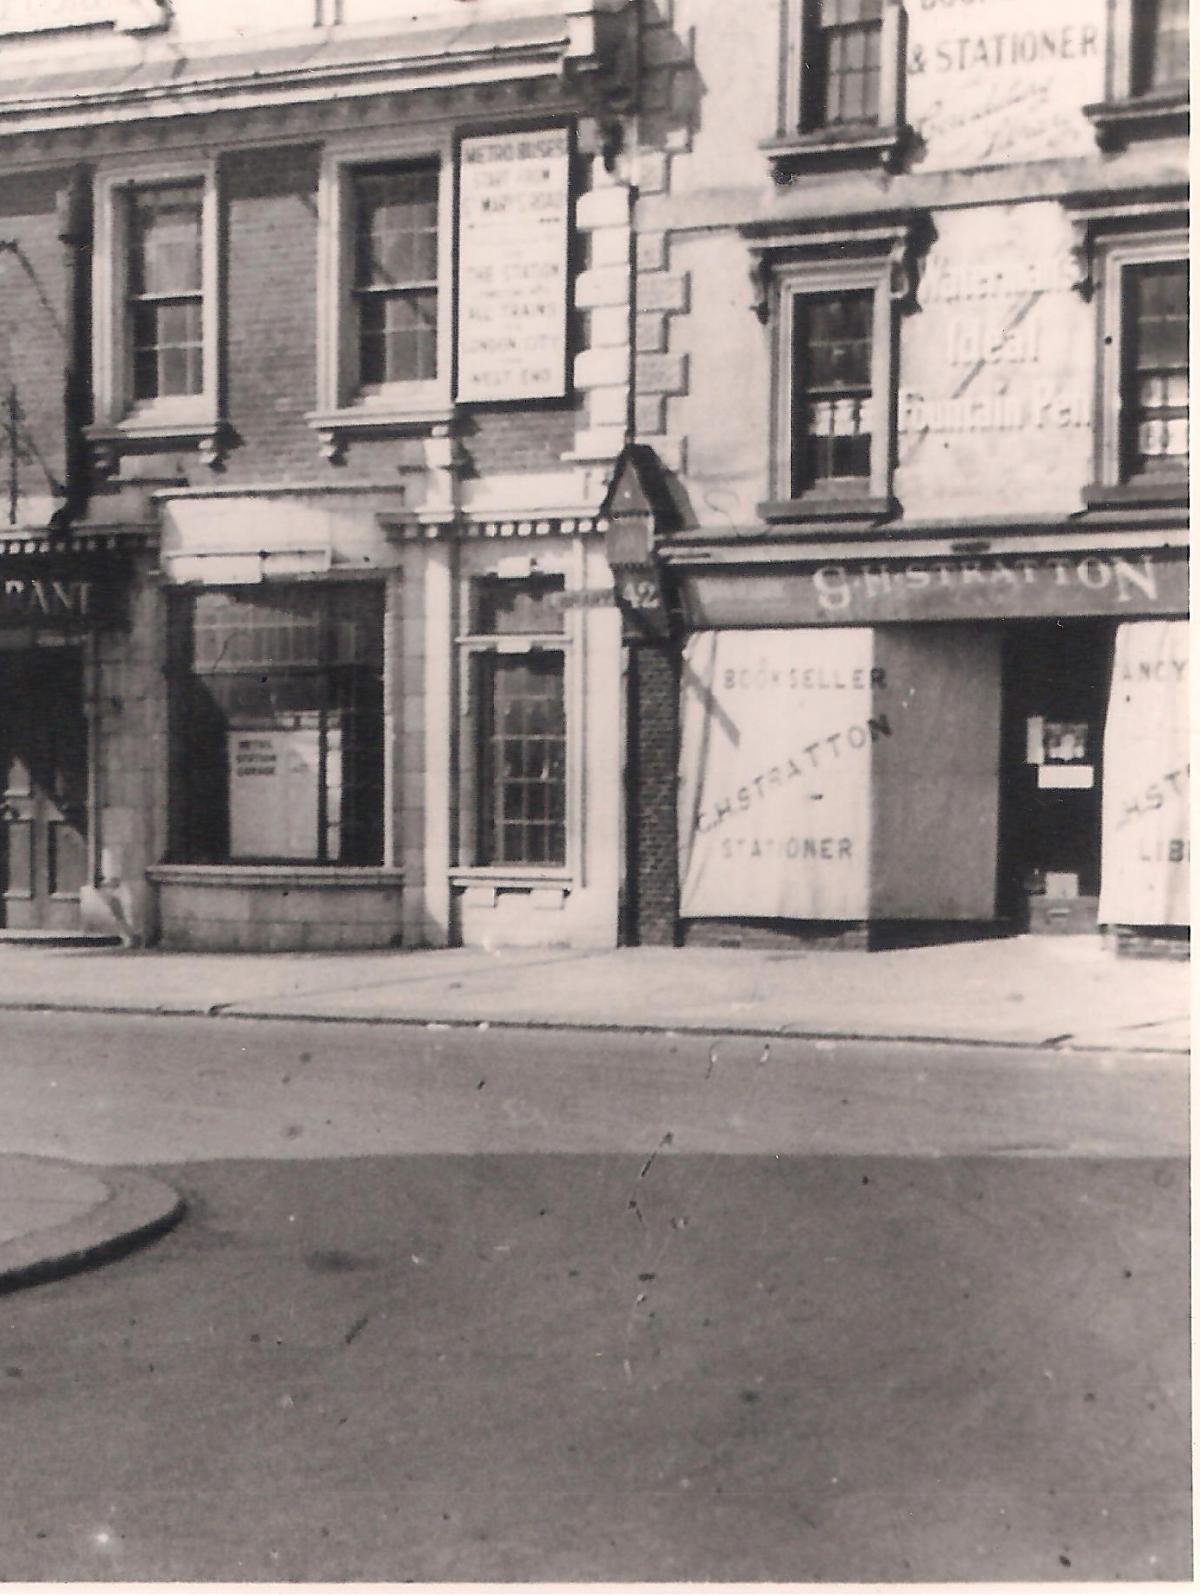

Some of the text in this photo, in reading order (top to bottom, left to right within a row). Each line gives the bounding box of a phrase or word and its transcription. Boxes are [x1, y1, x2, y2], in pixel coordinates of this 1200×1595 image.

[907, 24, 1098, 75] & STATIONER
[622, 581, 659, 609] 42
[723, 666, 889, 691] BOOKSELLER
[722, 837, 854, 860] STATIONER
